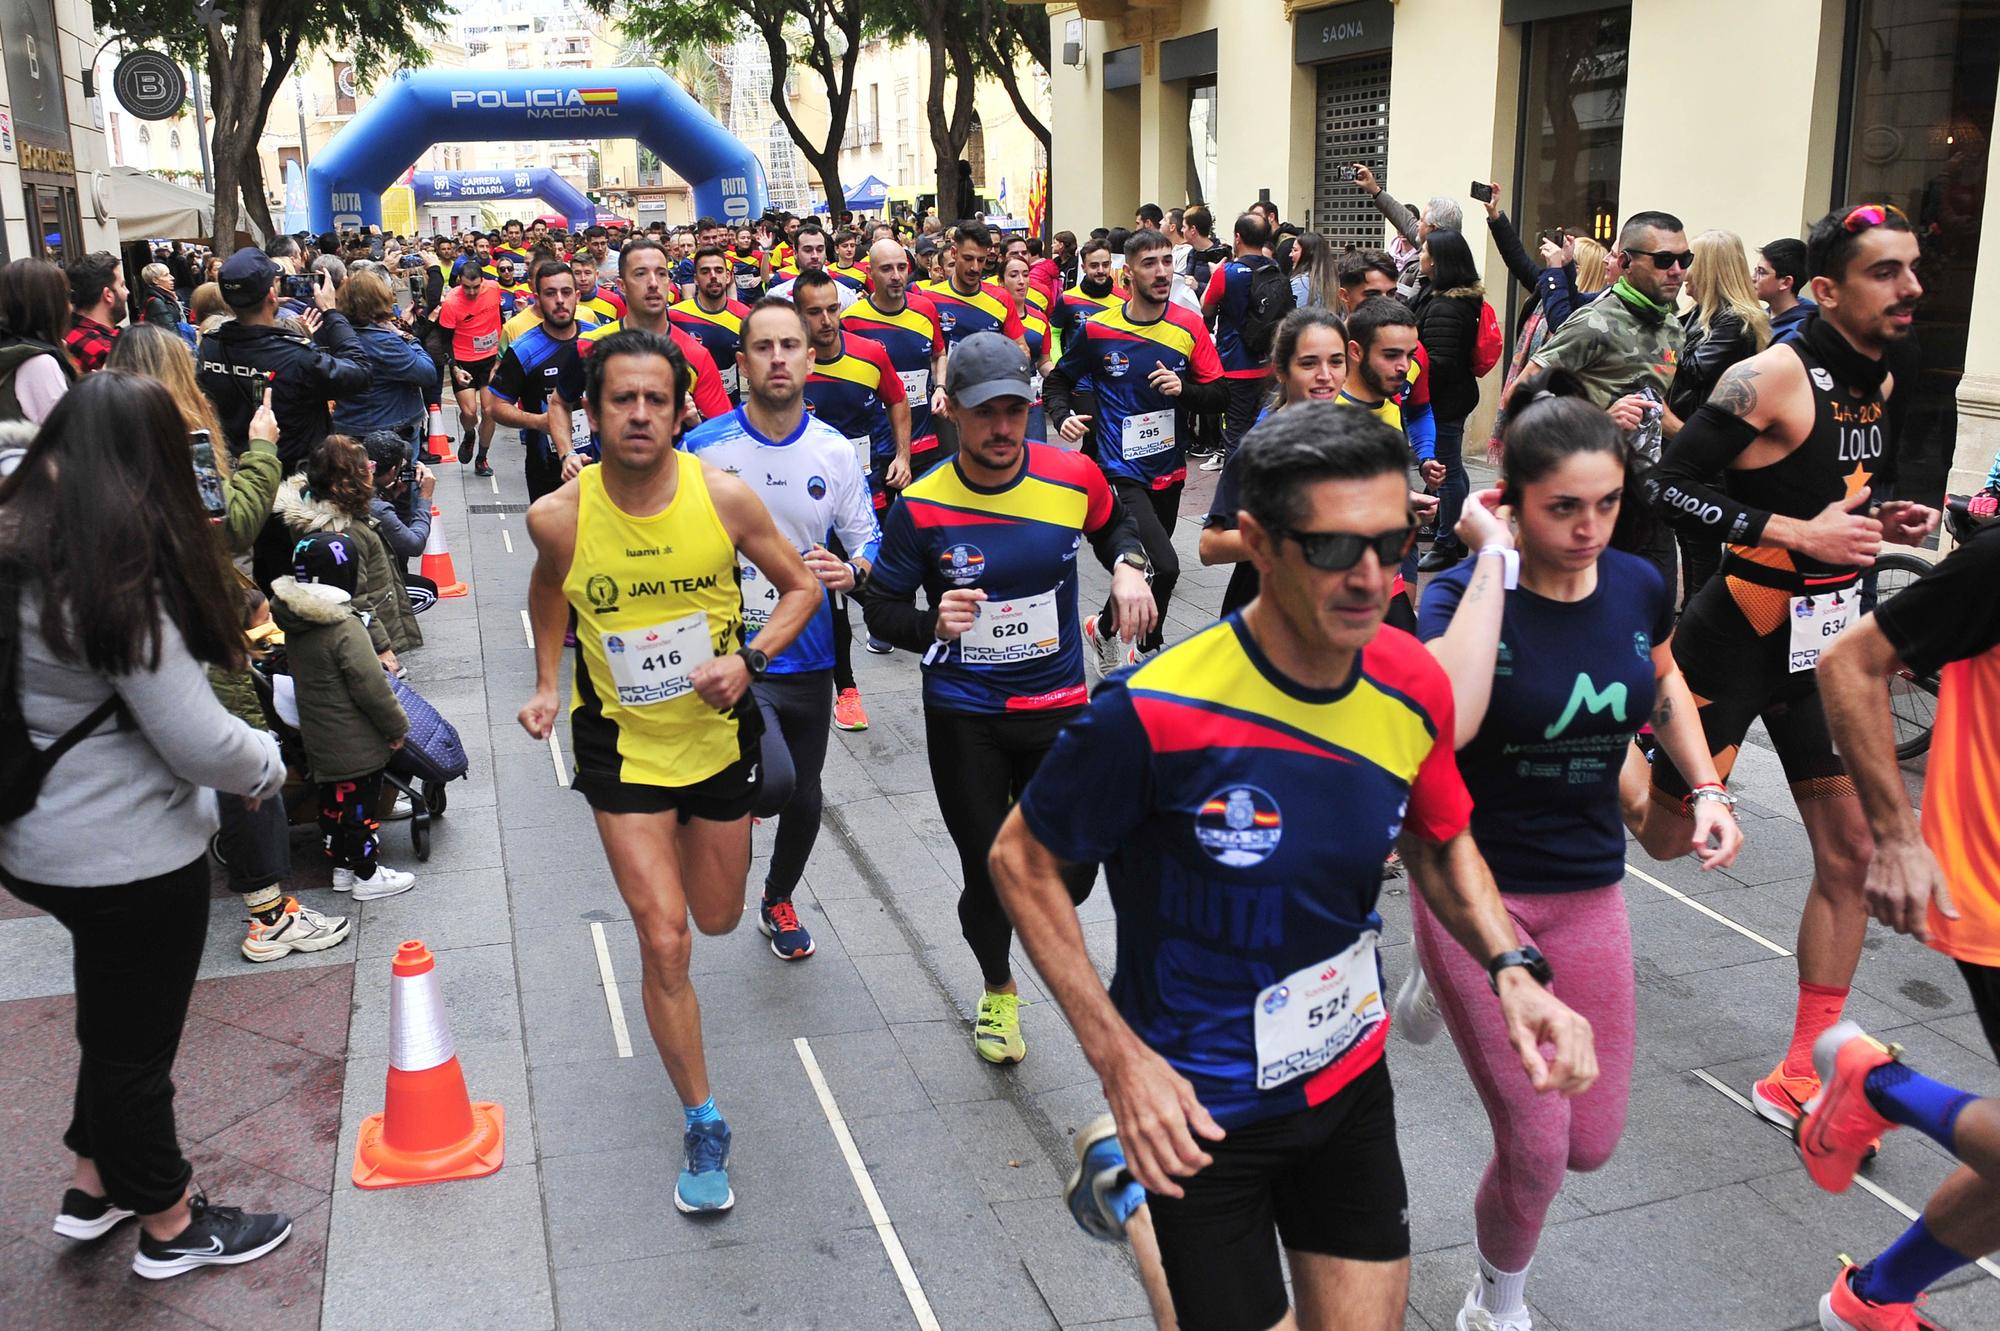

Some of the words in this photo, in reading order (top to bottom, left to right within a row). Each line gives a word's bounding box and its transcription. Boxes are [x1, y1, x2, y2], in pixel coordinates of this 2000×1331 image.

[1322, 21, 1364, 43] SAONA
[134, 71, 167, 99] B
[527, 107, 619, 119] NACIONAL
[434, 180, 450, 190] 091
[462, 175, 502, 187] CARRERA
[515, 177, 531, 187] 091
[721, 177, 748, 196] RUTA
[460, 185, 506, 196] SOLIDARIA
[331, 192, 362, 212] RUTA
[203, 360, 258, 378] POLICIA
[1139, 427, 1160, 439] 295
[1124, 444, 1175, 458] NACIONAL
[1838, 424, 1882, 461] LOLO
[1663, 486, 1723, 525] Orona
[328, 541, 349, 566] R
[626, 547, 660, 557] luanvi
[628, 581, 666, 598] JAVI
[670, 574, 717, 594] TEAM
[992, 622, 1029, 638] 620
[642, 650, 682, 672] 416
[964, 647, 1060, 662] NACIONAL
[617, 674, 694, 694] POLICI
[620, 681, 694, 704] NACION
